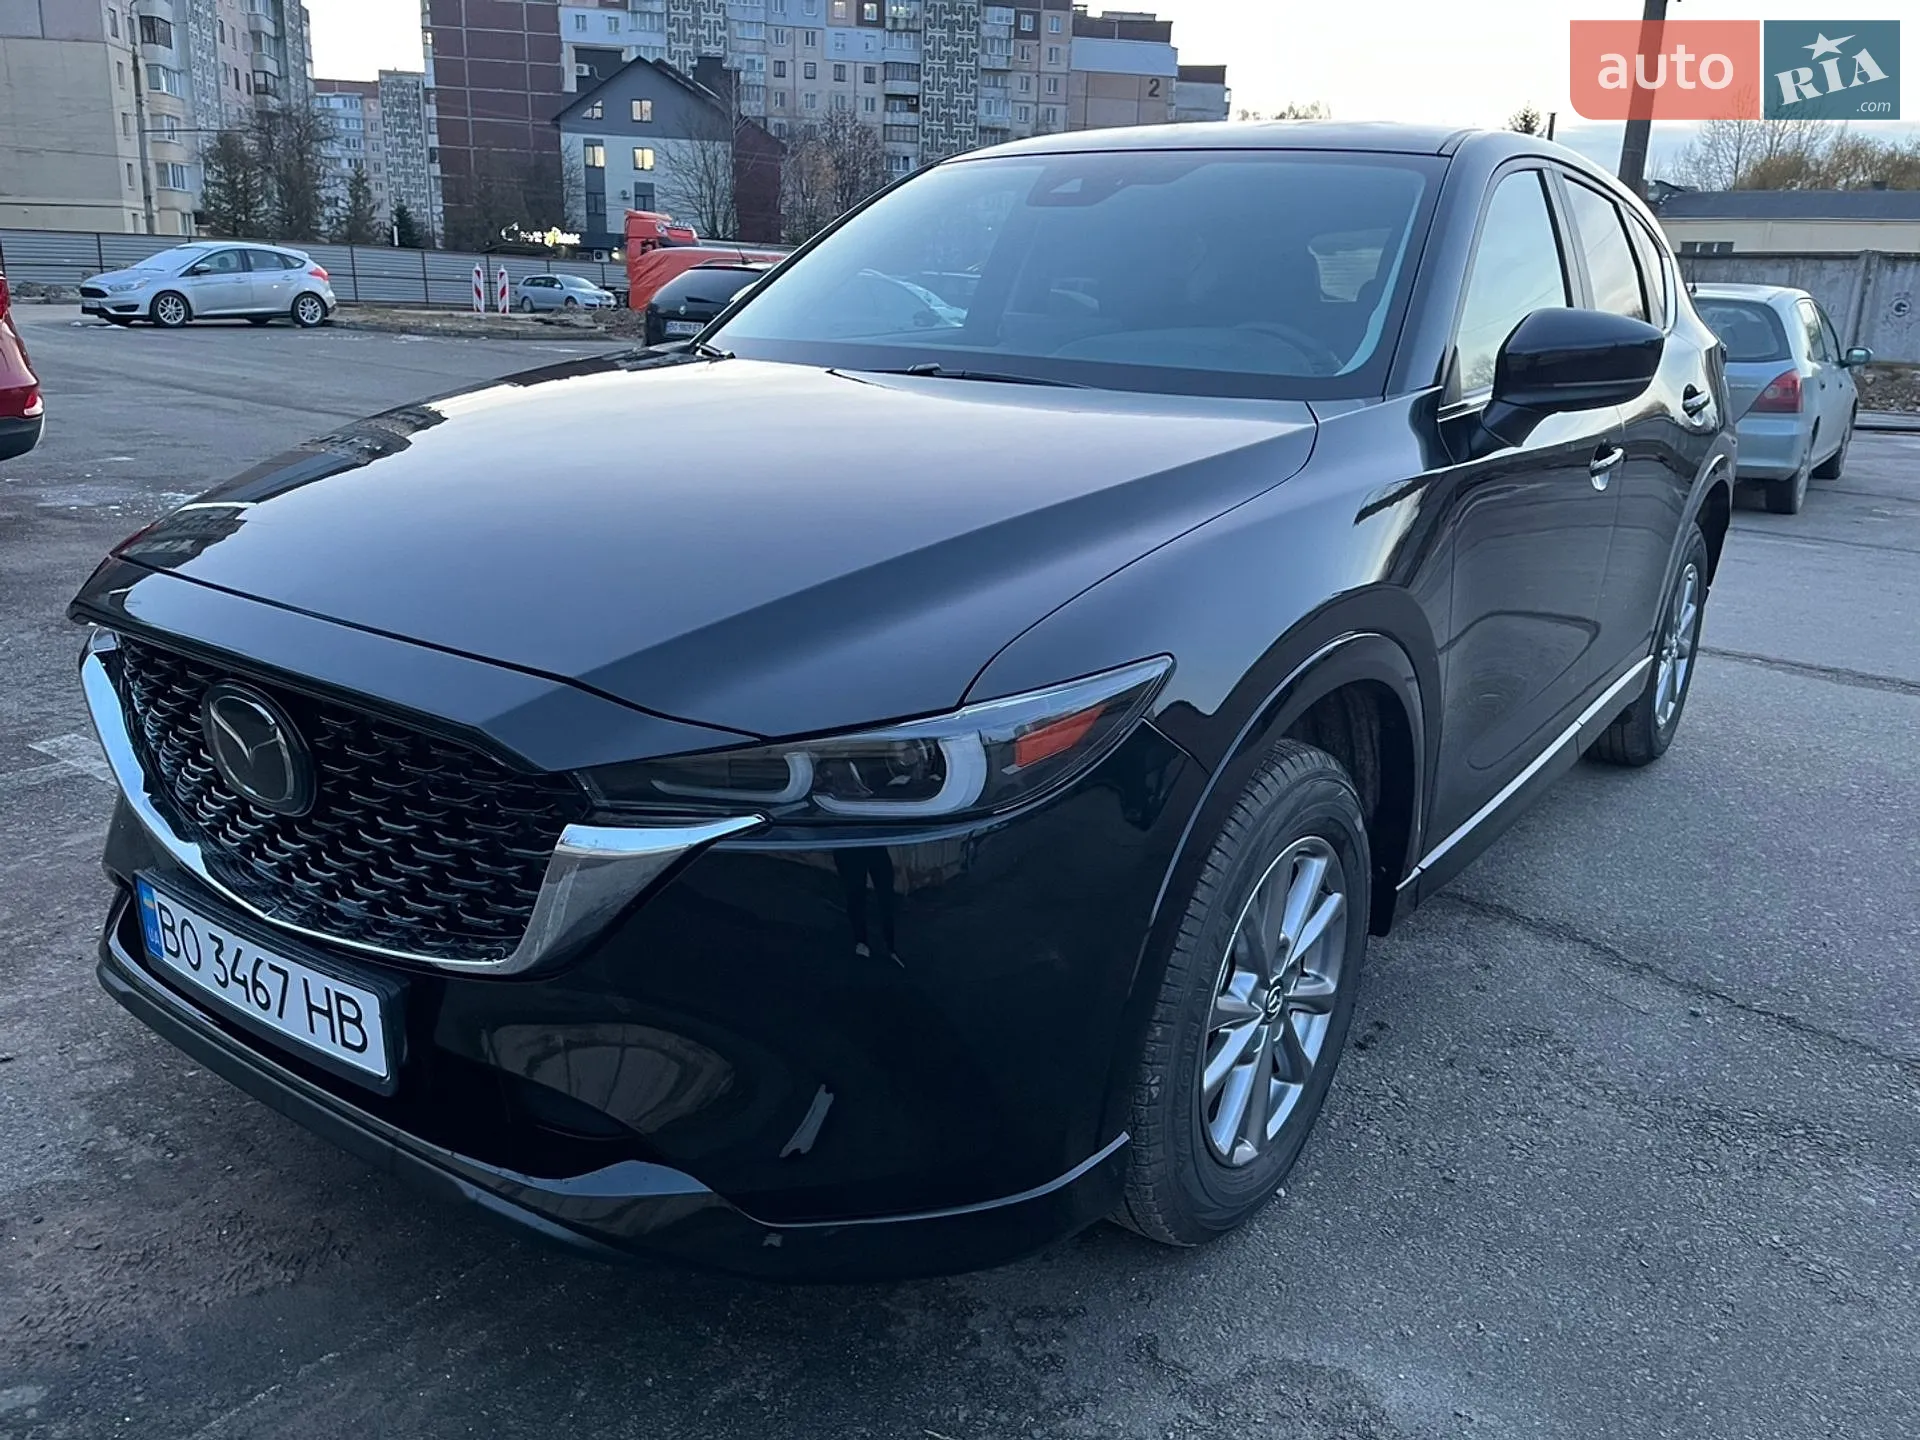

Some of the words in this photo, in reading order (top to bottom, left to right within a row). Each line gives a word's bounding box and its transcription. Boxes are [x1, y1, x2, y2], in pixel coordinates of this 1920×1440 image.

[1148, 78, 1160, 97] 2
[157, 902, 201, 971] BO
[208, 932, 289, 1019] 3467
[303, 976, 368, 1053] HB
